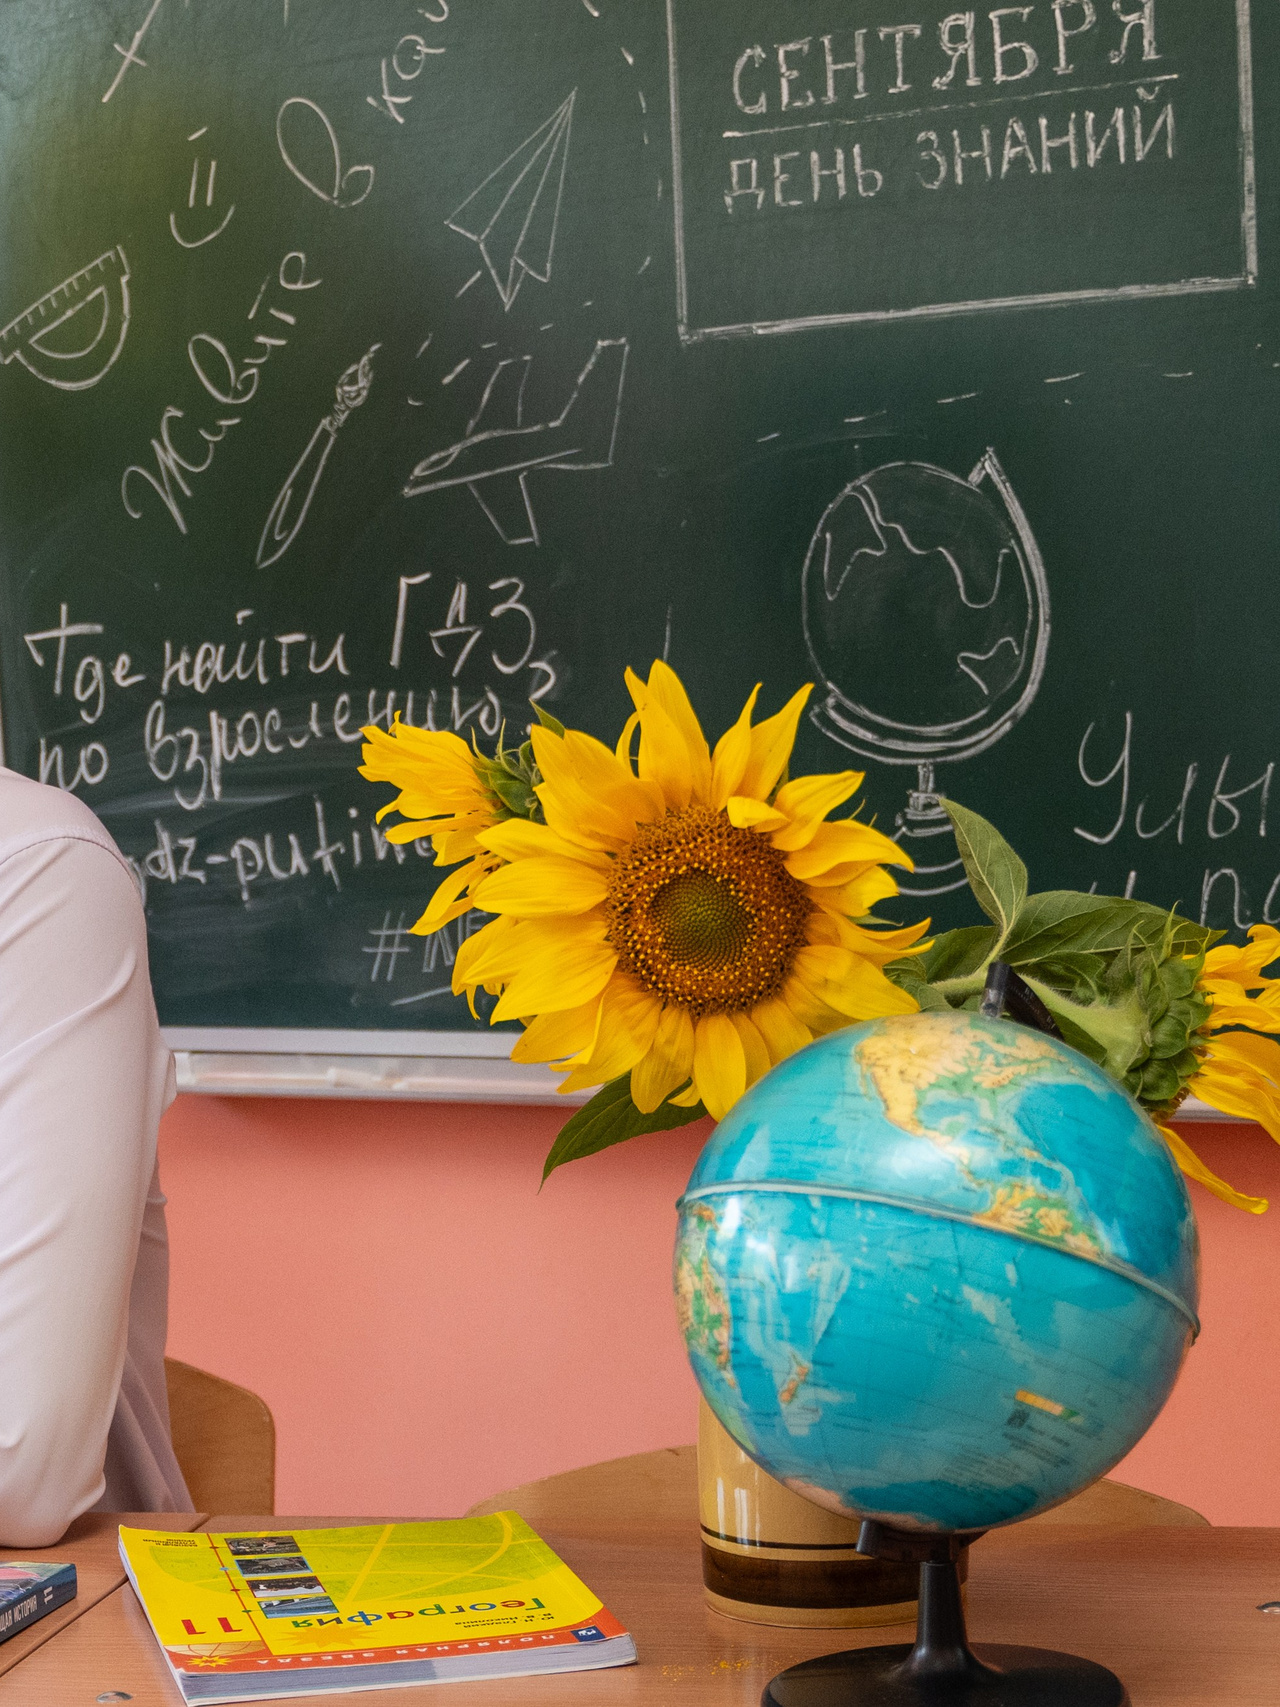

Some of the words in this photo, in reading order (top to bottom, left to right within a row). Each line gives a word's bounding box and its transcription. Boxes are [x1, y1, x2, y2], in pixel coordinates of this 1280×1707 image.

[731, 0, 1163, 115] СЕНТЯБРЯ
[723, 143, 883, 214] ДЕНЬ
[916, 84, 1175, 190] ЗНАНИЙ
[121, 251, 321, 534] Живите
[162, 609, 351, 694] найти
[389, 572, 536, 676] ГДЗ
[39, 736, 109, 790] по
[13, 1595, 38, 1623] ИСТОРИЯ
[181, 1617, 243, 1635] 11
[291, 1597, 546, 1628] География
[257, 1652, 375, 1665] ЗВЕЗДА
[396, 1635, 554, 1655] ПОЛЯРНАЯ
